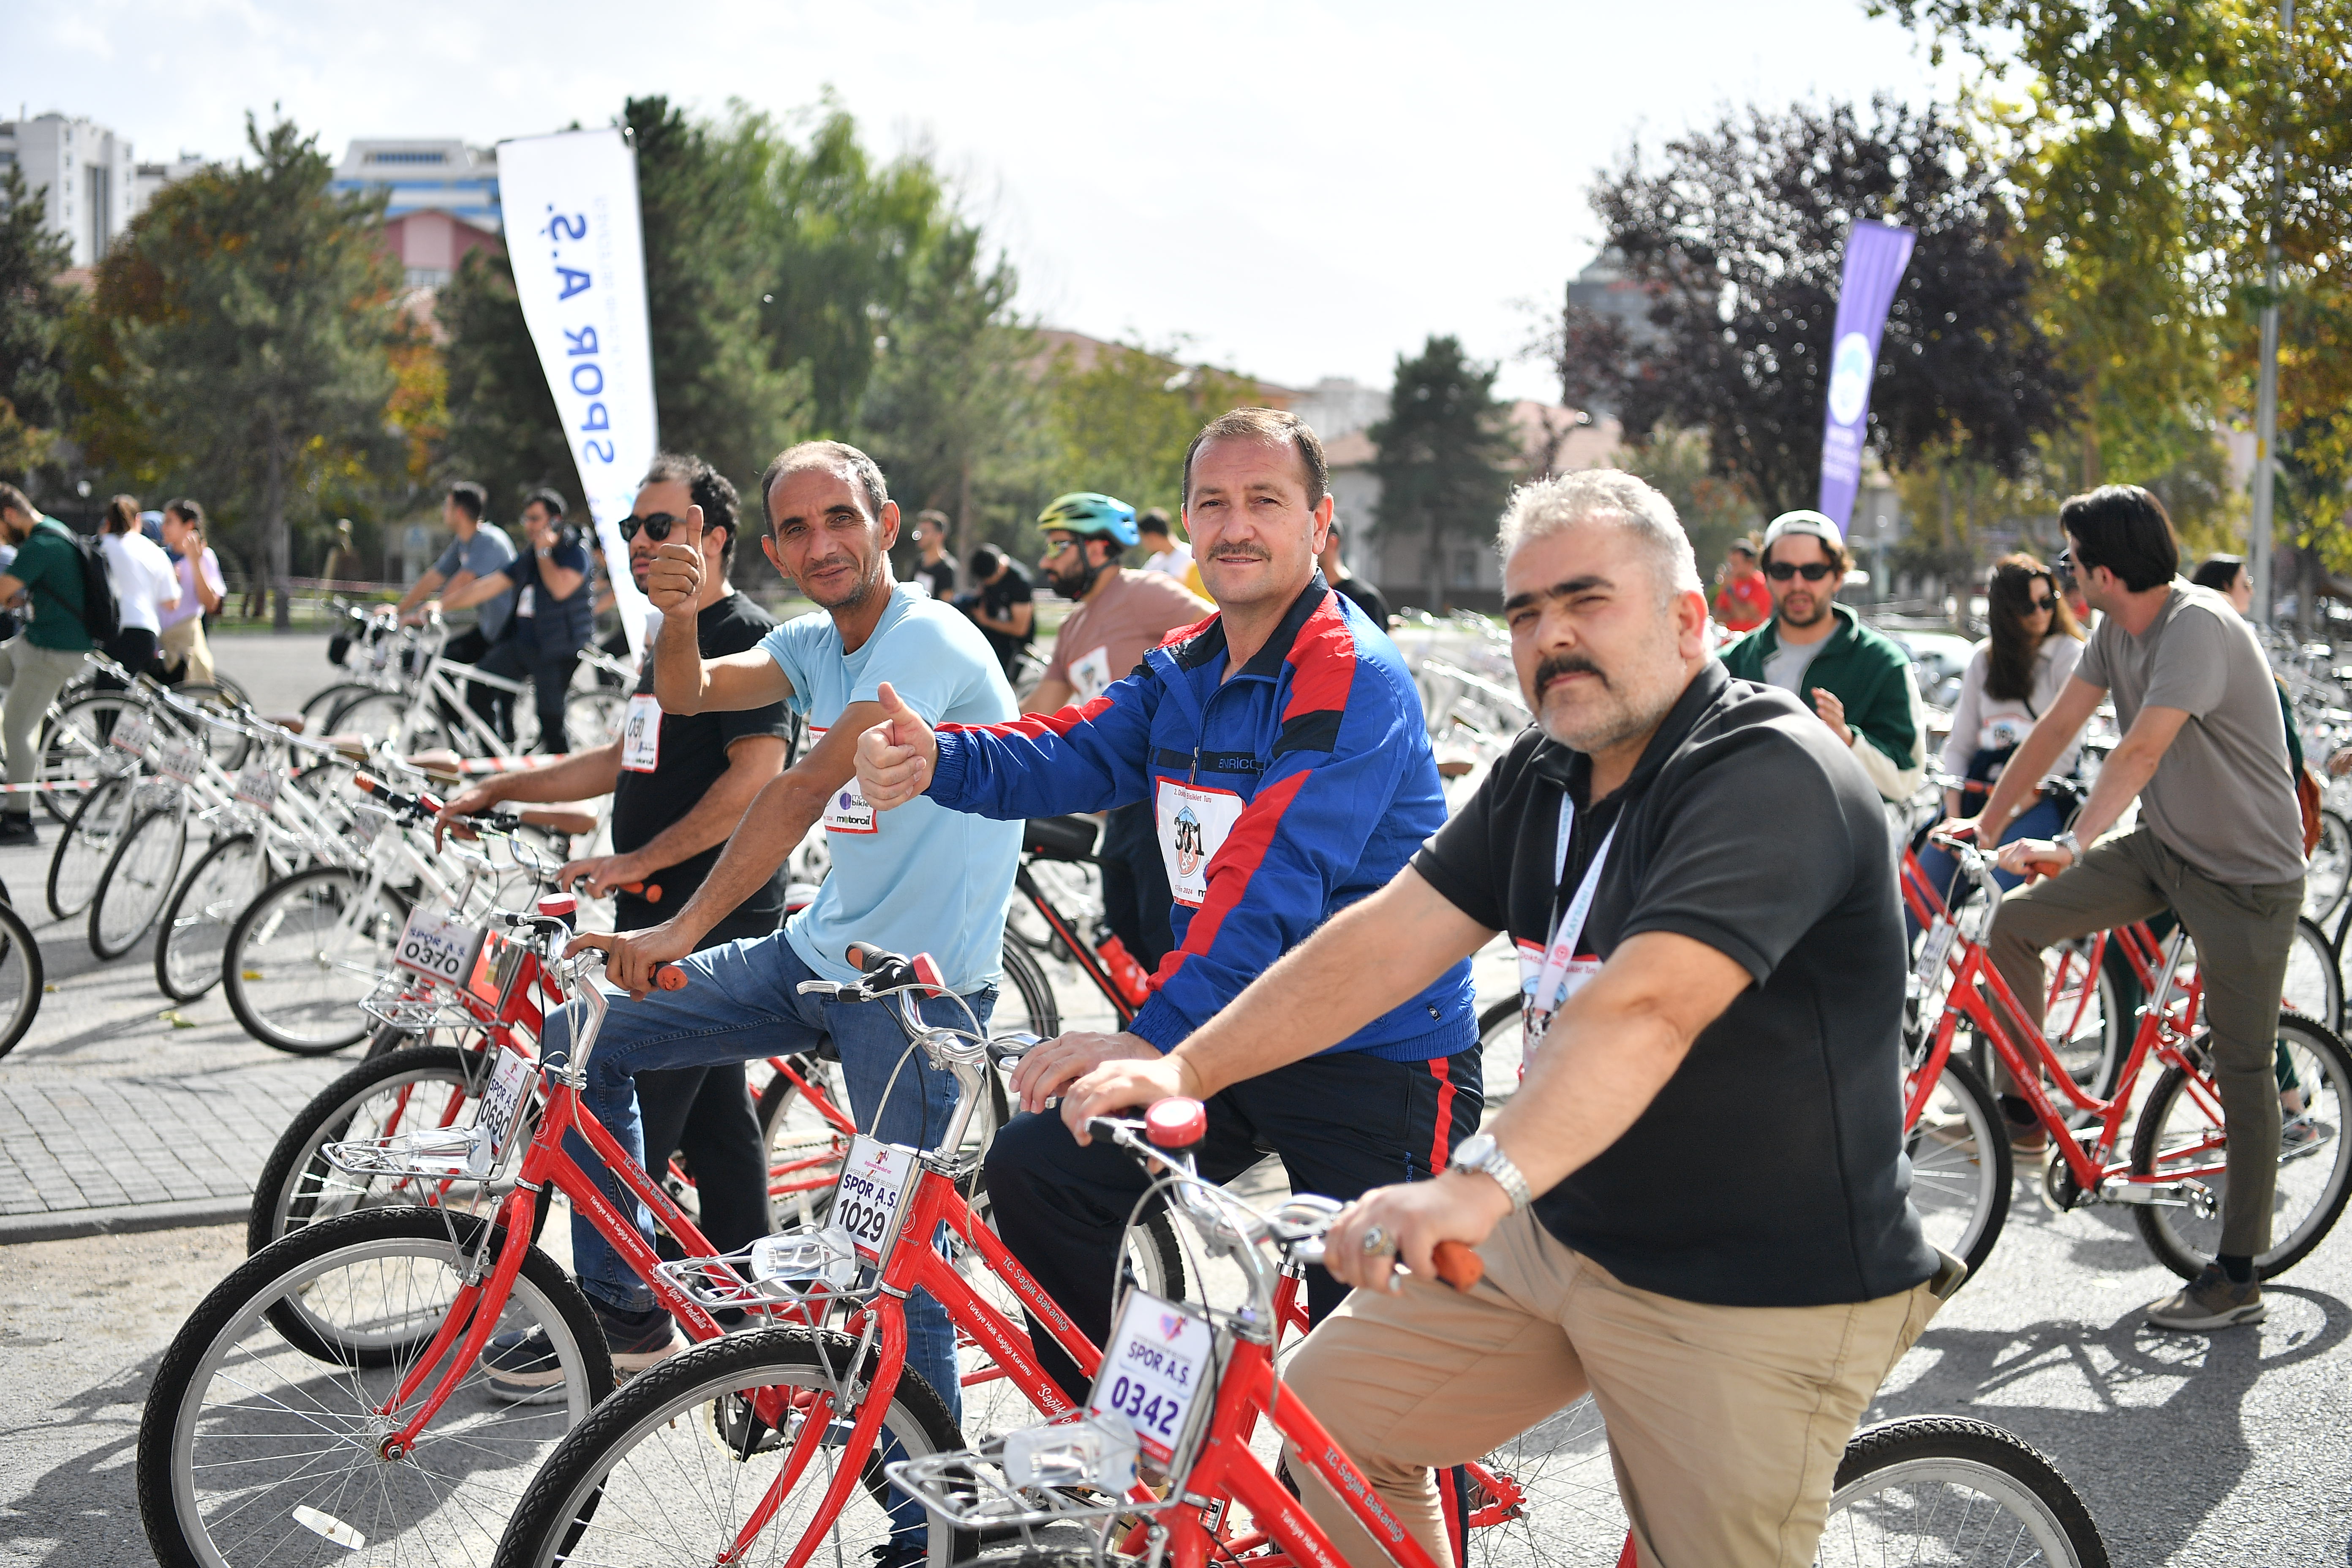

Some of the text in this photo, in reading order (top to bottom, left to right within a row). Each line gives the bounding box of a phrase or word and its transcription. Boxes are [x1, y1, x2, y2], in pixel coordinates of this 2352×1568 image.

[1186, 792, 1201, 801] Bisiklet
[836, 815, 871, 825] motoroil
[409, 928, 441, 947] SPOR
[406, 942, 459, 974] 0370
[490, 1078, 506, 1102] SPOR
[480, 1098, 511, 1142] 0690
[847, 1167, 860, 1176] KAYSERİ
[843, 1174, 896, 1211] SPOR A.Ş.
[590, 1195, 606, 1215] Türkiye
[604, 1213, 616, 1226] Halk
[626, 1237, 645, 1258] Kurumu
[838, 1198, 885, 1243] 1029
[1003, 1255, 1070, 1332] T.C. Sağlık Bakanlığı
[967, 1299, 1032, 1376] Türkiye Halk Sağlığı Kurumu
[1128, 1341, 1162, 1372] SPOR
[1111, 1376, 1179, 1436] 0342
